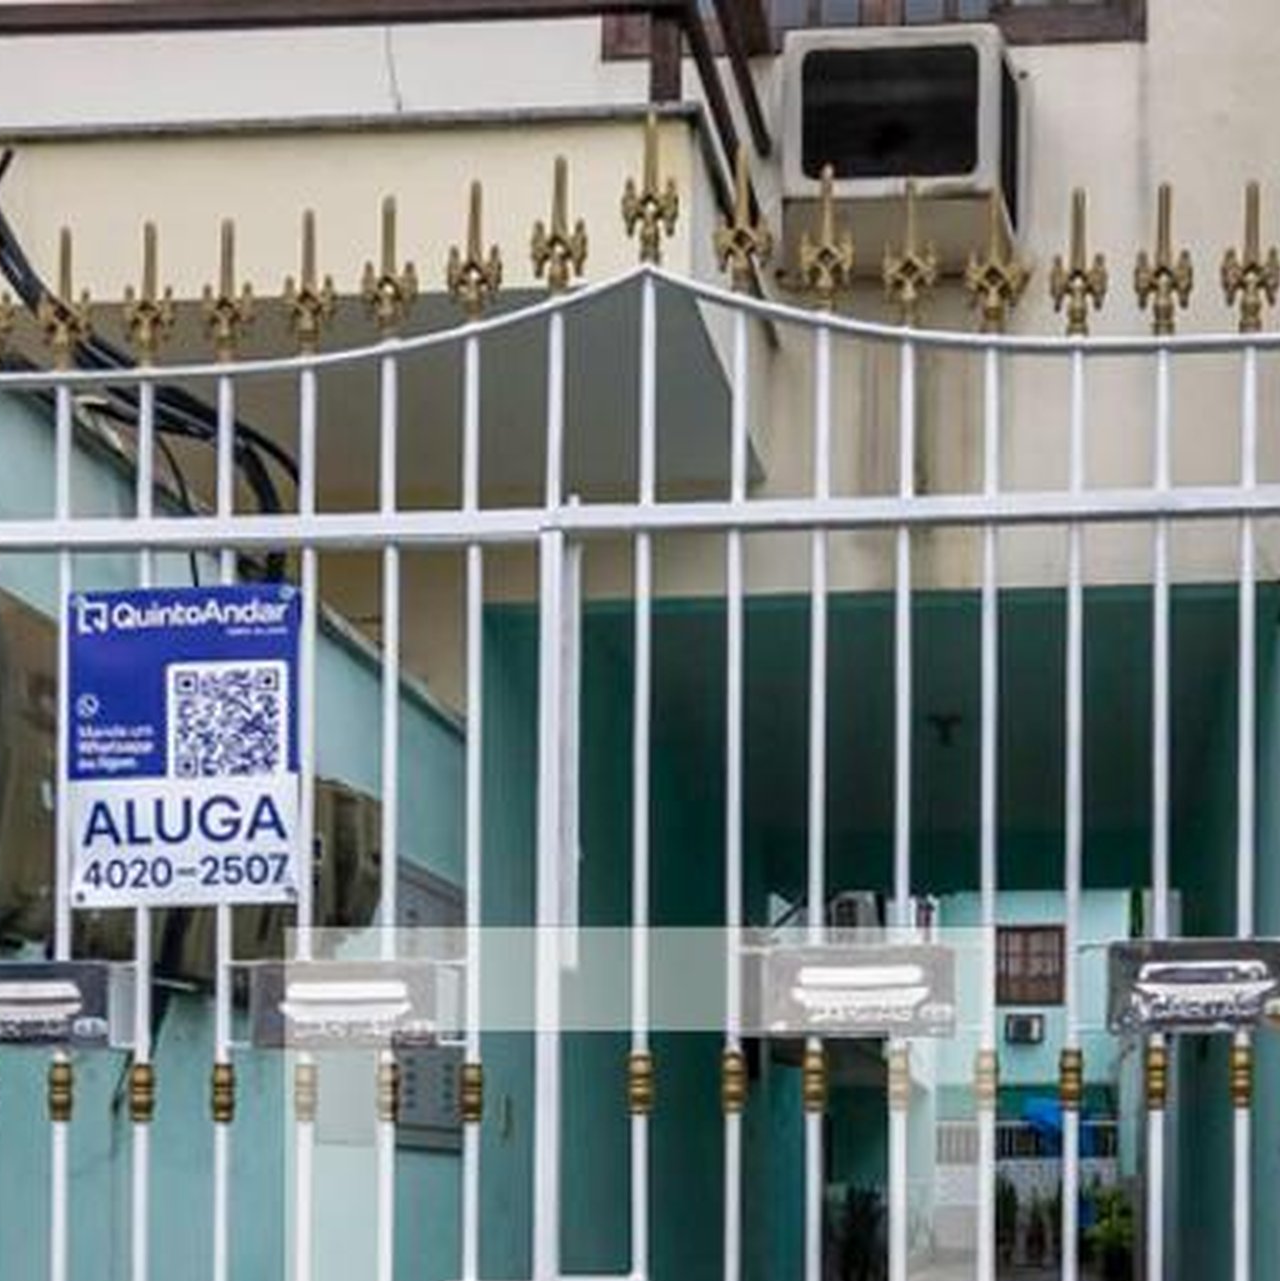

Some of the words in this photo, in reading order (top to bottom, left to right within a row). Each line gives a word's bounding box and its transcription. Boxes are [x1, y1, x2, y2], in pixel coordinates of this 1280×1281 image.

[111, 598, 289, 629] QuintoAndar
[82, 794, 288, 847] ALUGA
[83, 853, 290, 890] 4020-2507
